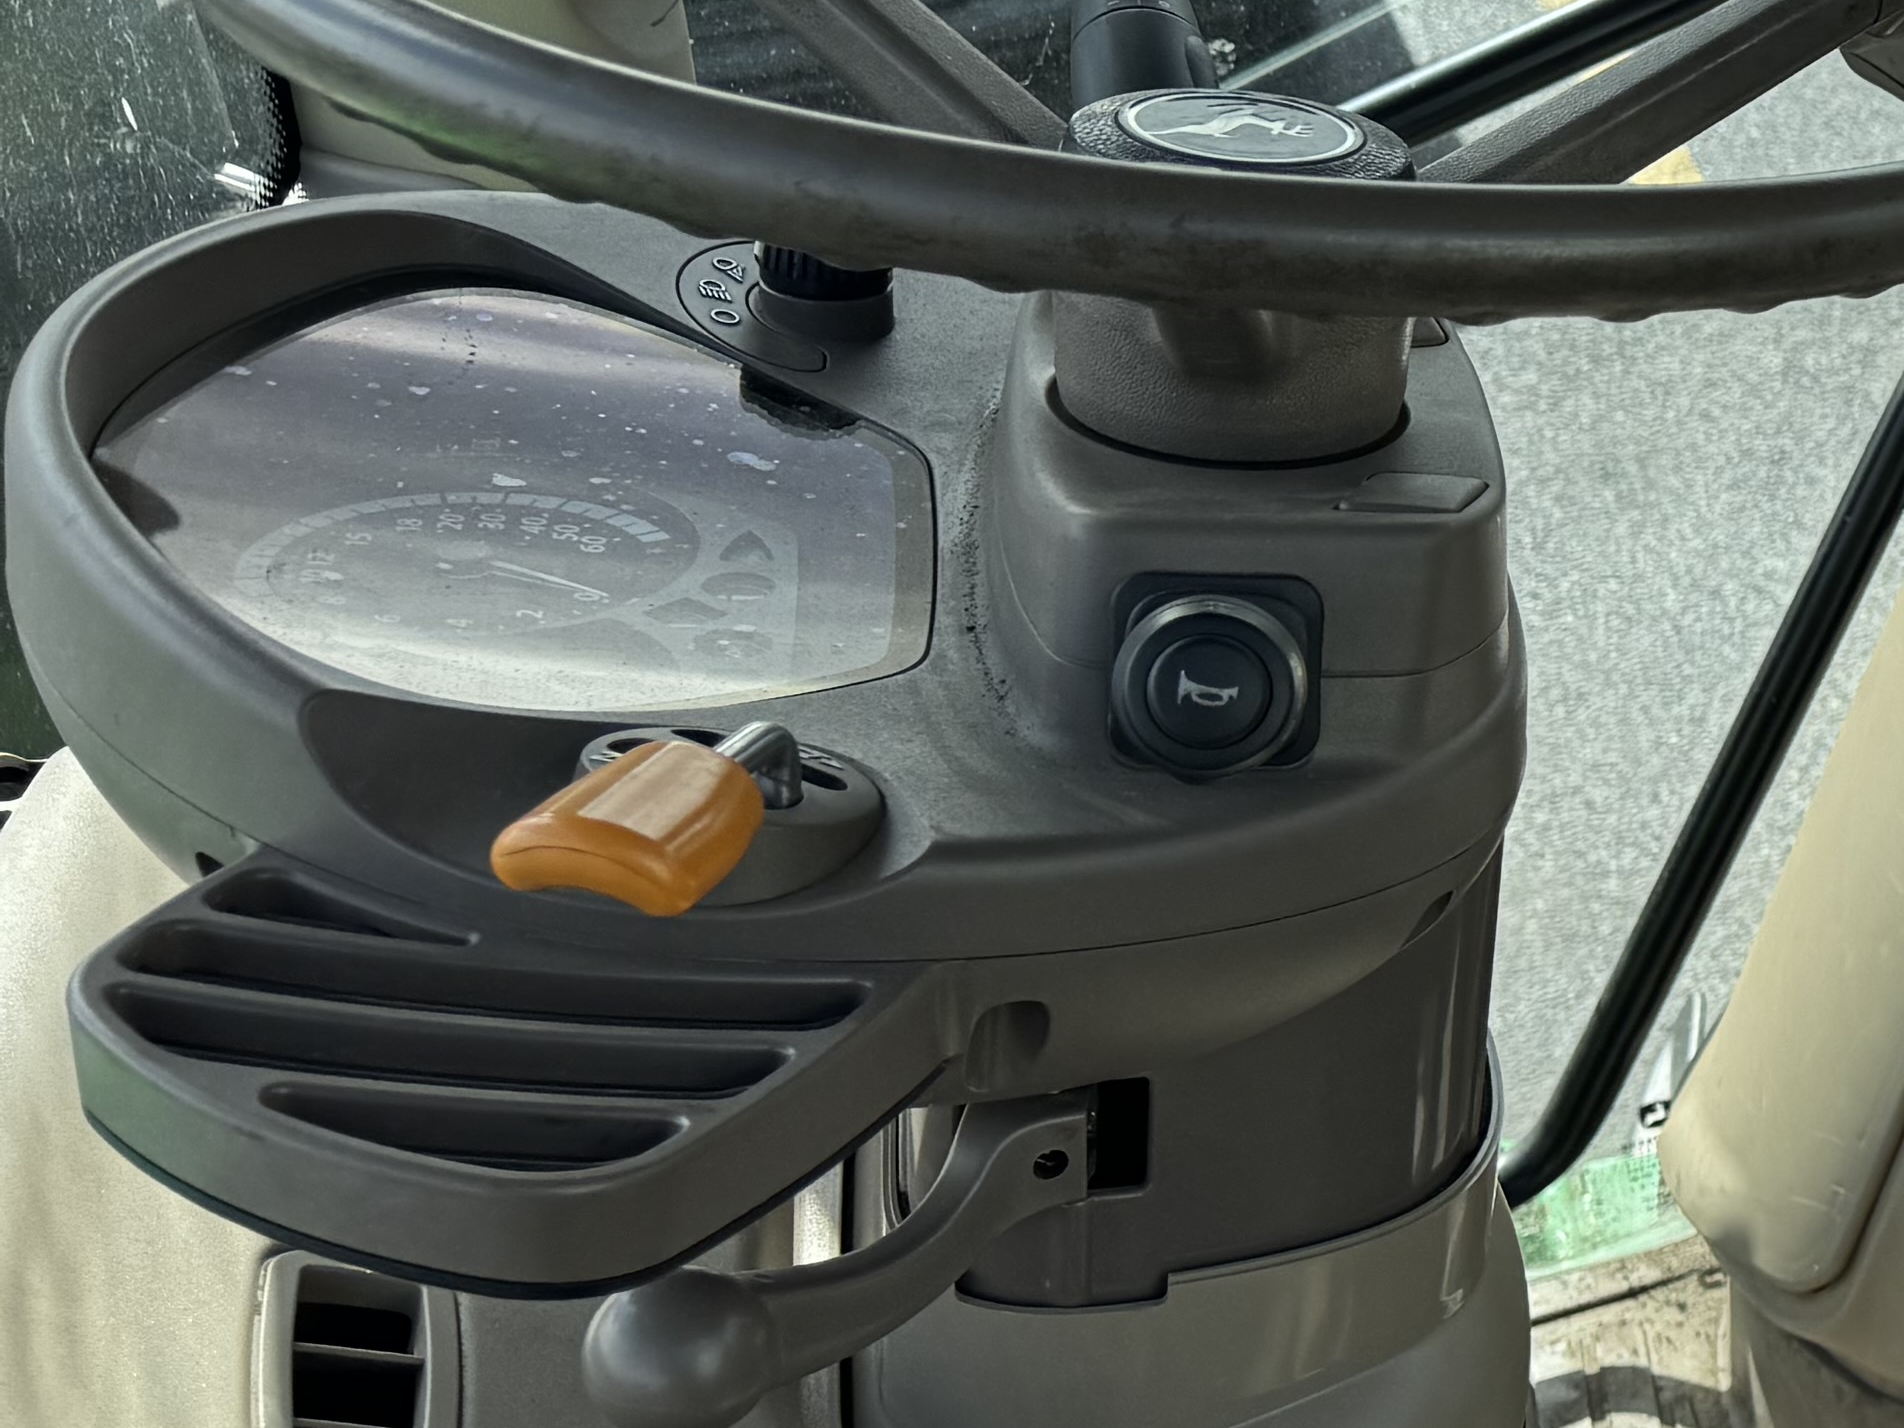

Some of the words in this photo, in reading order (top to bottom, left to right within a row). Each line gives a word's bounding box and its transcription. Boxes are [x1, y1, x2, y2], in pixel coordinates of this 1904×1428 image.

[395, 518, 422, 531] 18
[436, 513, 465, 530] 20
[478, 513, 506, 529] 30
[519, 517, 548, 534] 40
[344, 532, 372, 545] 15
[552, 524, 580, 541] 50
[580, 535, 607, 552] 60
[573, 592, 600, 601] 0
[516, 609, 543, 619] 2
